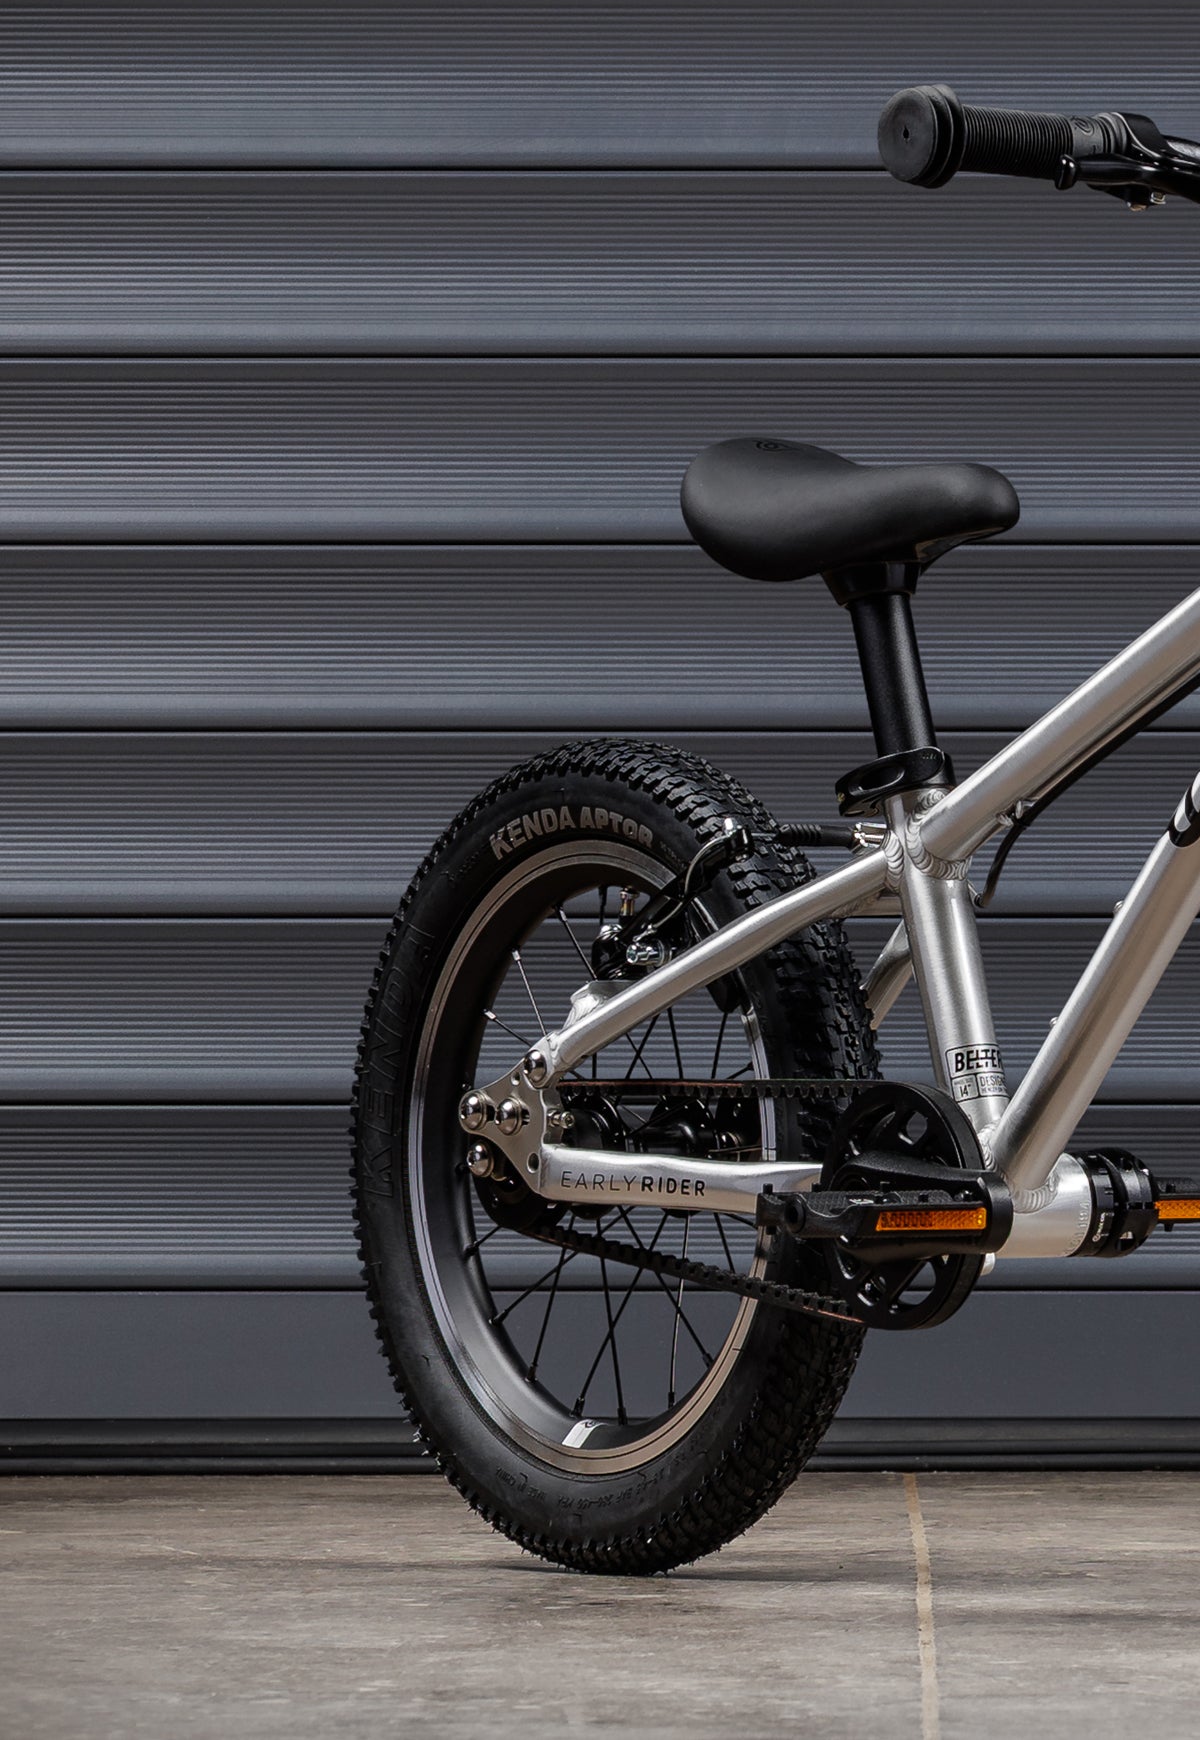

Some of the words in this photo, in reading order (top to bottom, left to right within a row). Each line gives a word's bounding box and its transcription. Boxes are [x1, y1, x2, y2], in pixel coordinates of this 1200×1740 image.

[489, 806, 577, 860] KENDA
[579, 806, 655, 849] APTOR
[358, 923, 436, 1197] KENDA
